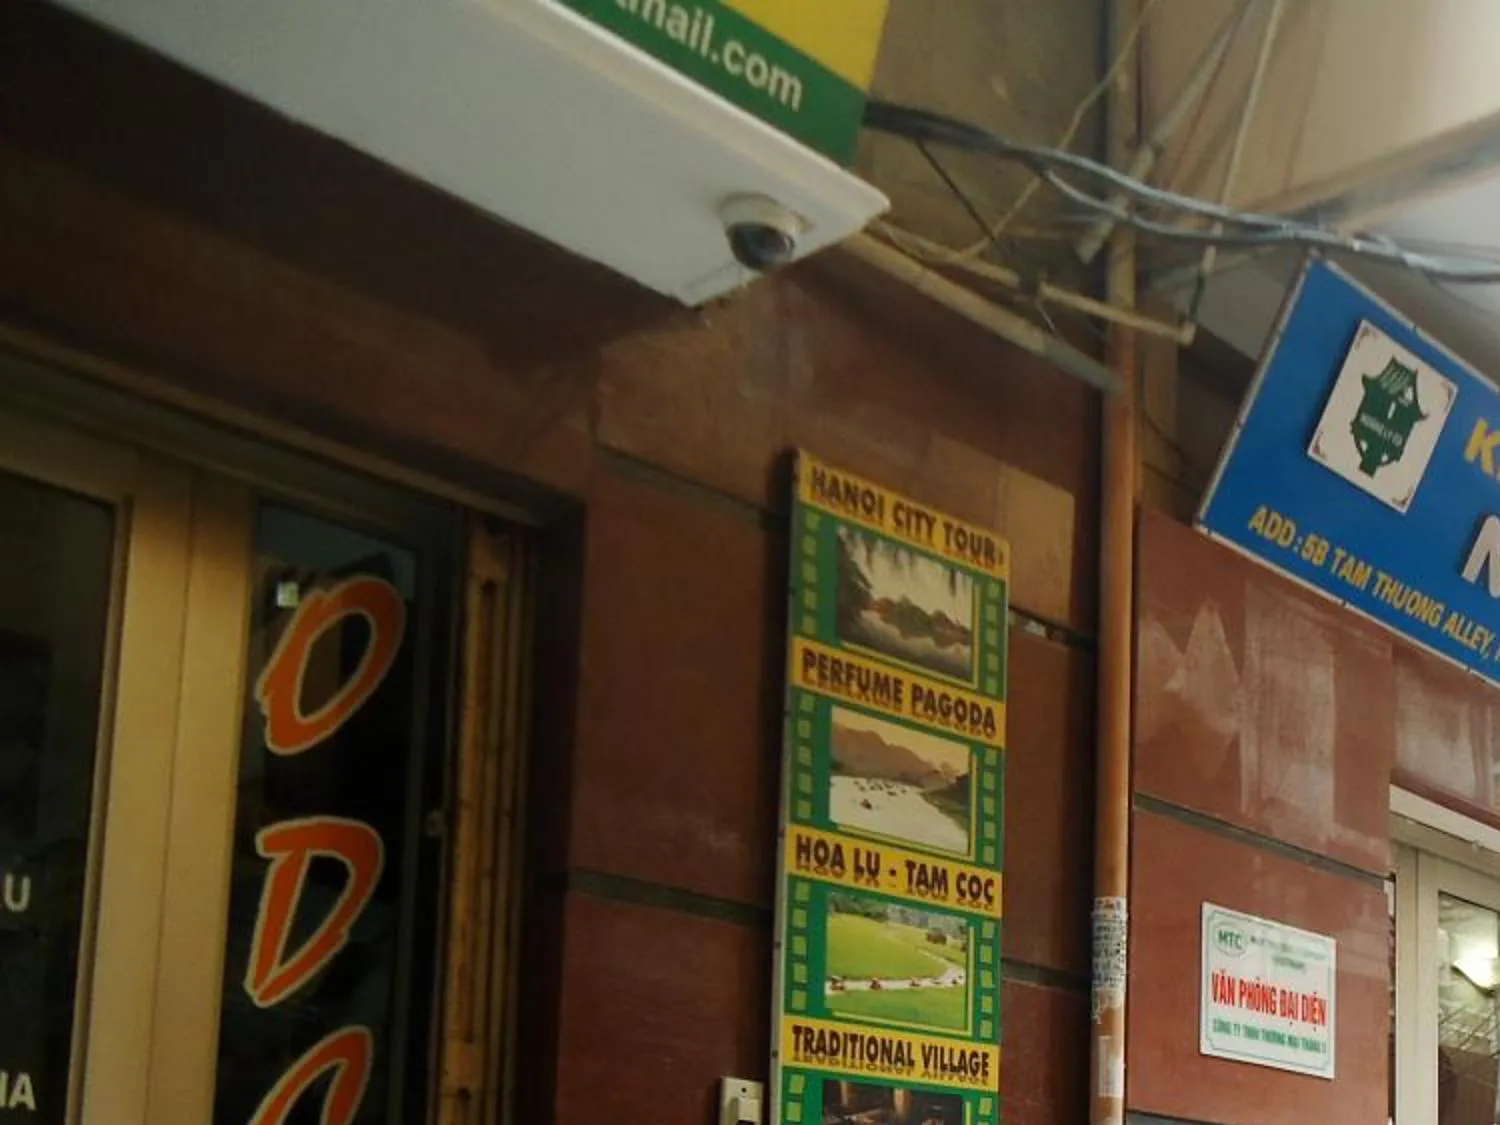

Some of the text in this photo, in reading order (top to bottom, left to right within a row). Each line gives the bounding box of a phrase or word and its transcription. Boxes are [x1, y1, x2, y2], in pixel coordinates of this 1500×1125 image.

[811, 465, 996, 566] HANOI CITY TOUR
[1331, 548, 1373, 591] TAM
[802, 647, 996, 738] PERFUME PAGODA
[796, 833, 995, 905] HOA LU TAM COC
[1211, 968, 1236, 1006] VĂN
[792, 1025, 990, 1077] TRADITIONAL VILLAGE
